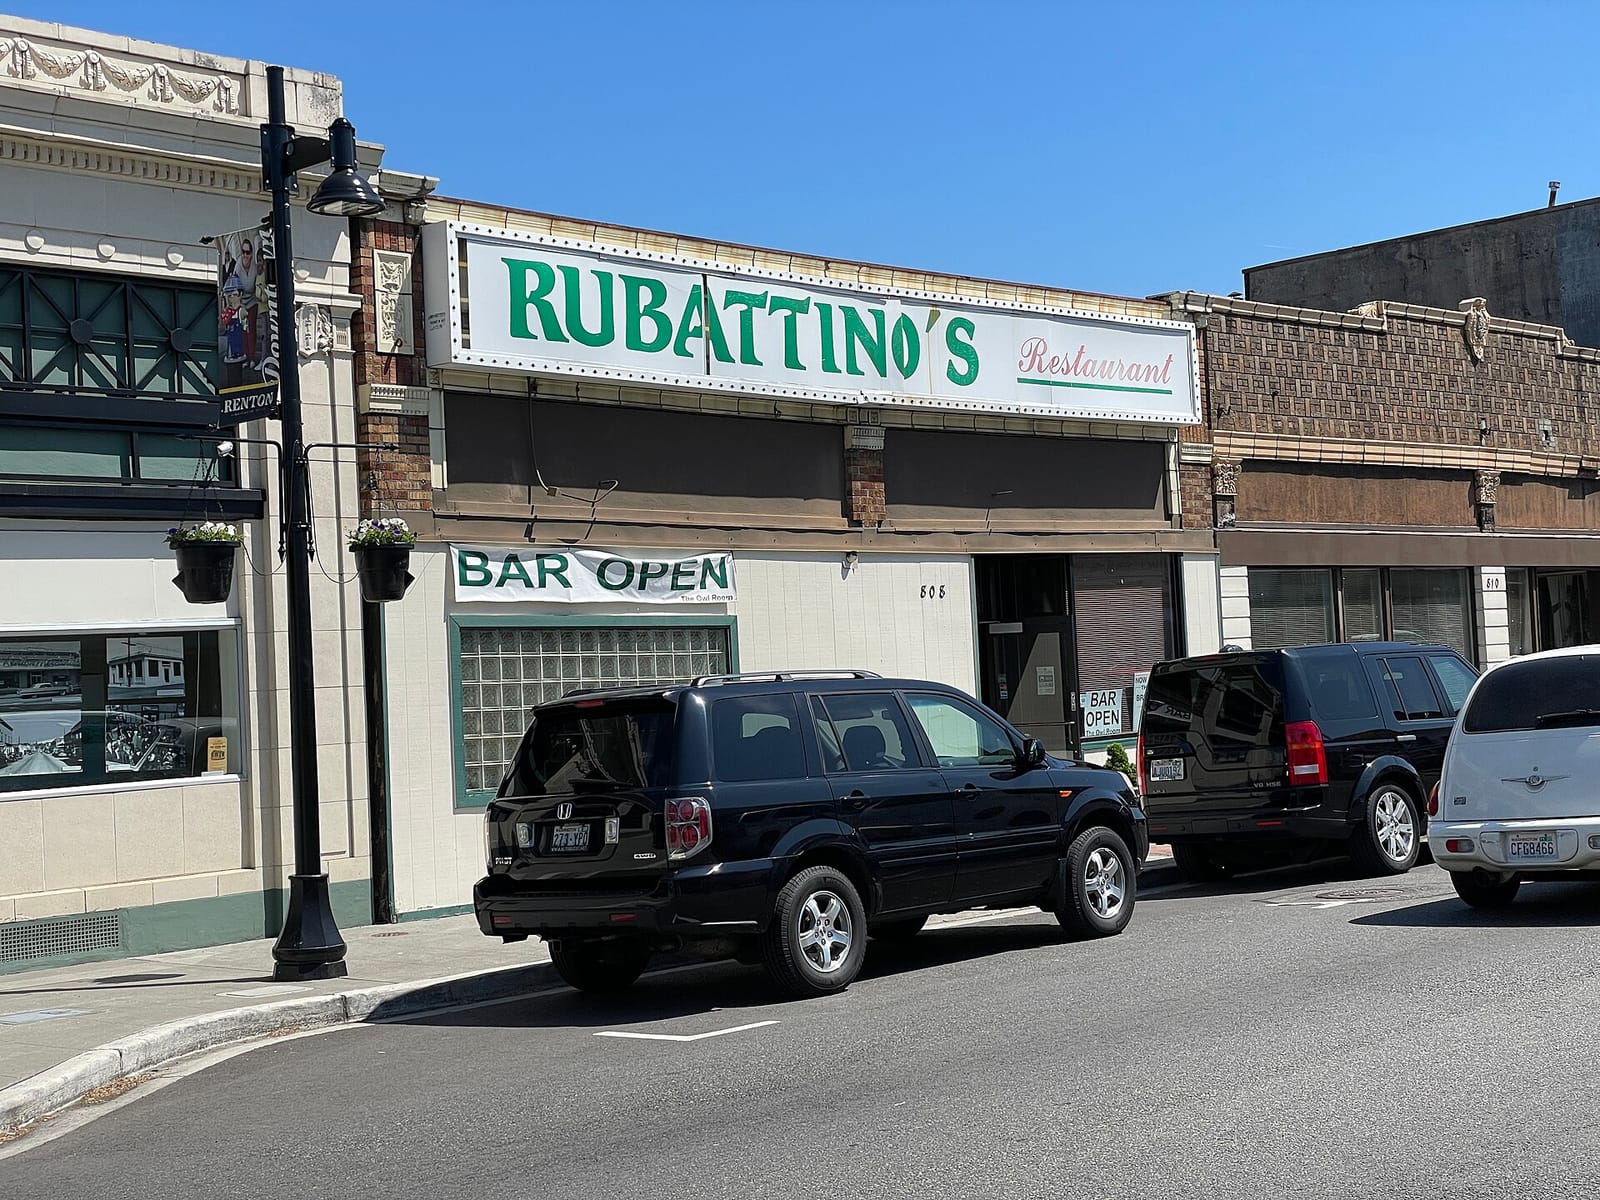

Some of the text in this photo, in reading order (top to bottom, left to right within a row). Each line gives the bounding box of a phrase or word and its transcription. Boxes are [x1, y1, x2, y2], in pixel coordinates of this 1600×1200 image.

[500, 257, 980, 387] RUBATTINO'S
[1018, 336, 1174, 385] Restaurant
[224, 391, 274, 414] RENTON
[457, 550, 729, 591] BAR OPEN
[920, 584, 946, 600] 808
[1486, 577, 1500, 589] 810
[1090, 691, 1117, 708] BAR
[1086, 710, 1120, 728] OPEN
[1511, 842, 1554, 856] CFG8466
